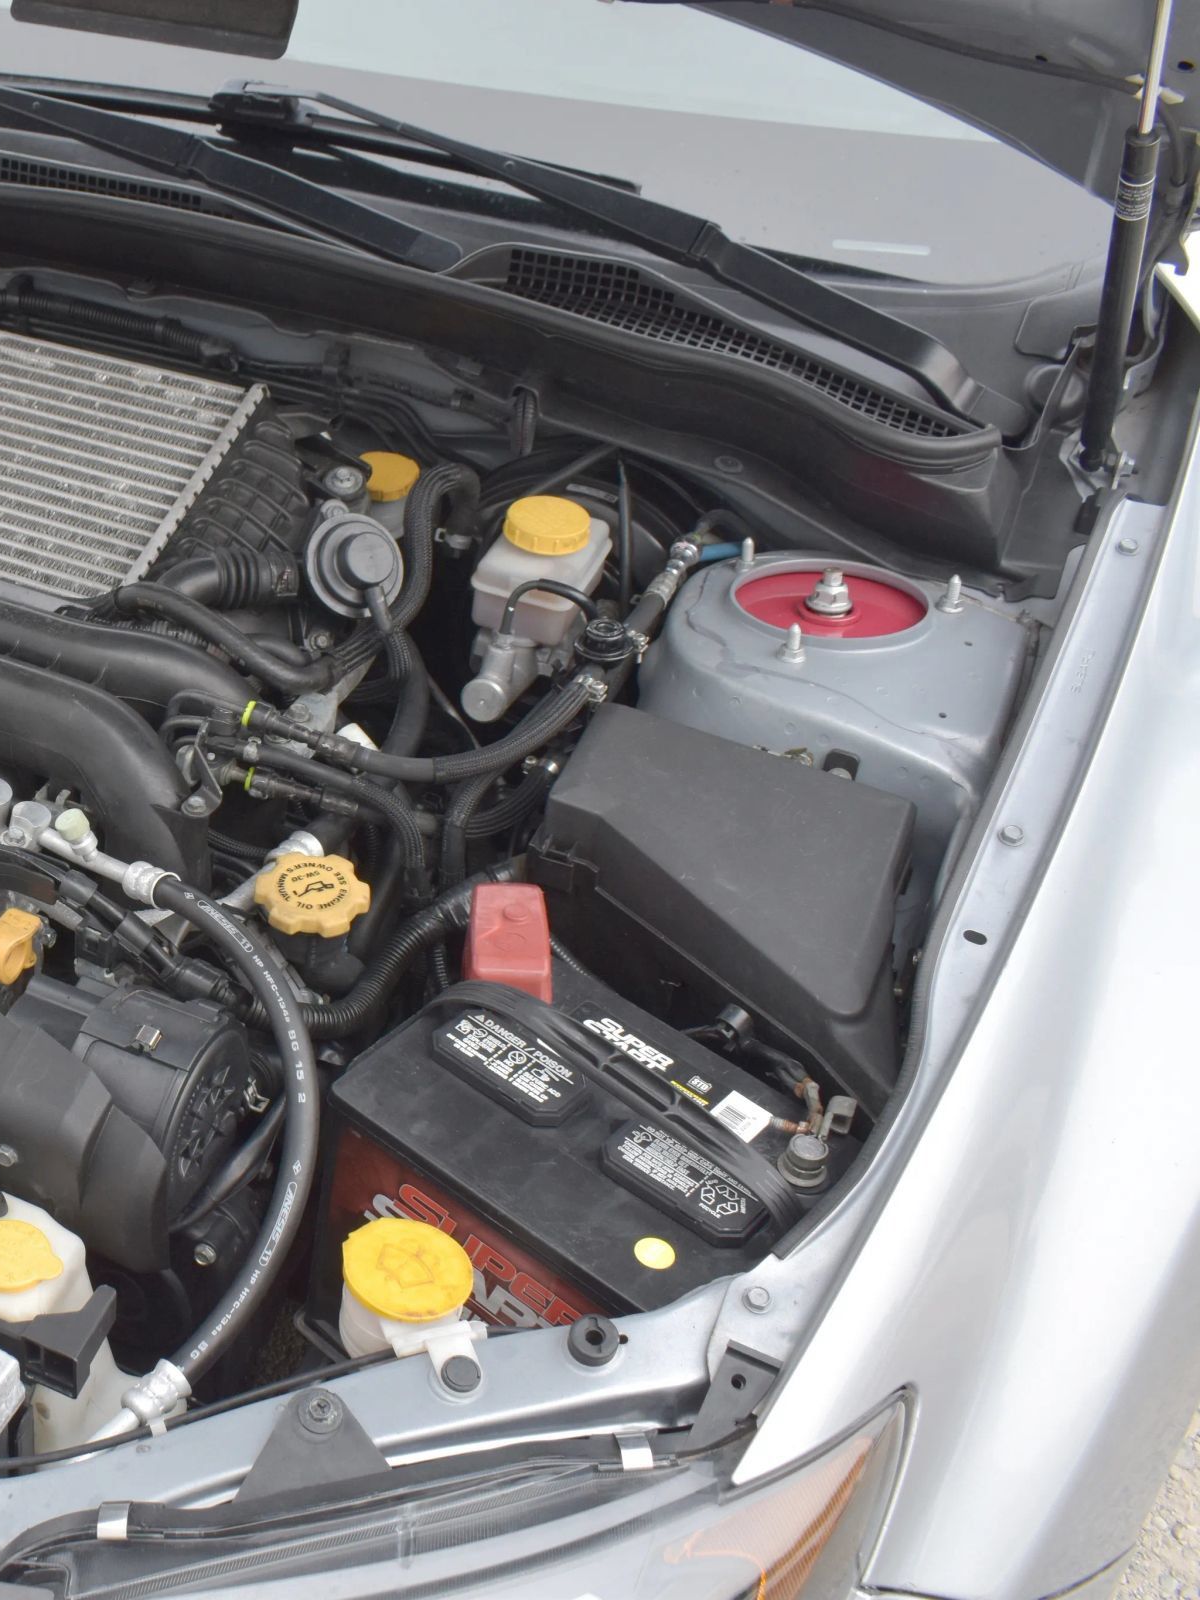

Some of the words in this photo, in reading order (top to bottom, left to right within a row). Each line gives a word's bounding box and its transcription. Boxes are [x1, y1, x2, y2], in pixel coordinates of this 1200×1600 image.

[286, 862, 333, 873] OWNER'S
[291, 870, 320, 882] 5W-30
[277, 873, 291, 902] MANUAL
[334, 871, 347, 886] SEE
[296, 901, 313, 910] OIL
[319, 888, 348, 910] ENGINE
[252, 954, 264, 968] HP
[288, 1029, 300, 1051] BG
[484, 1019, 527, 1049] DANGER
[532, 1050, 573, 1079] POISON
[600, 1017, 675, 1068] SUPER
[690, 1078, 709, 1092] STD
[250, 1269, 261, 1285] HP
[190, 1339, 208, 1360] BG
